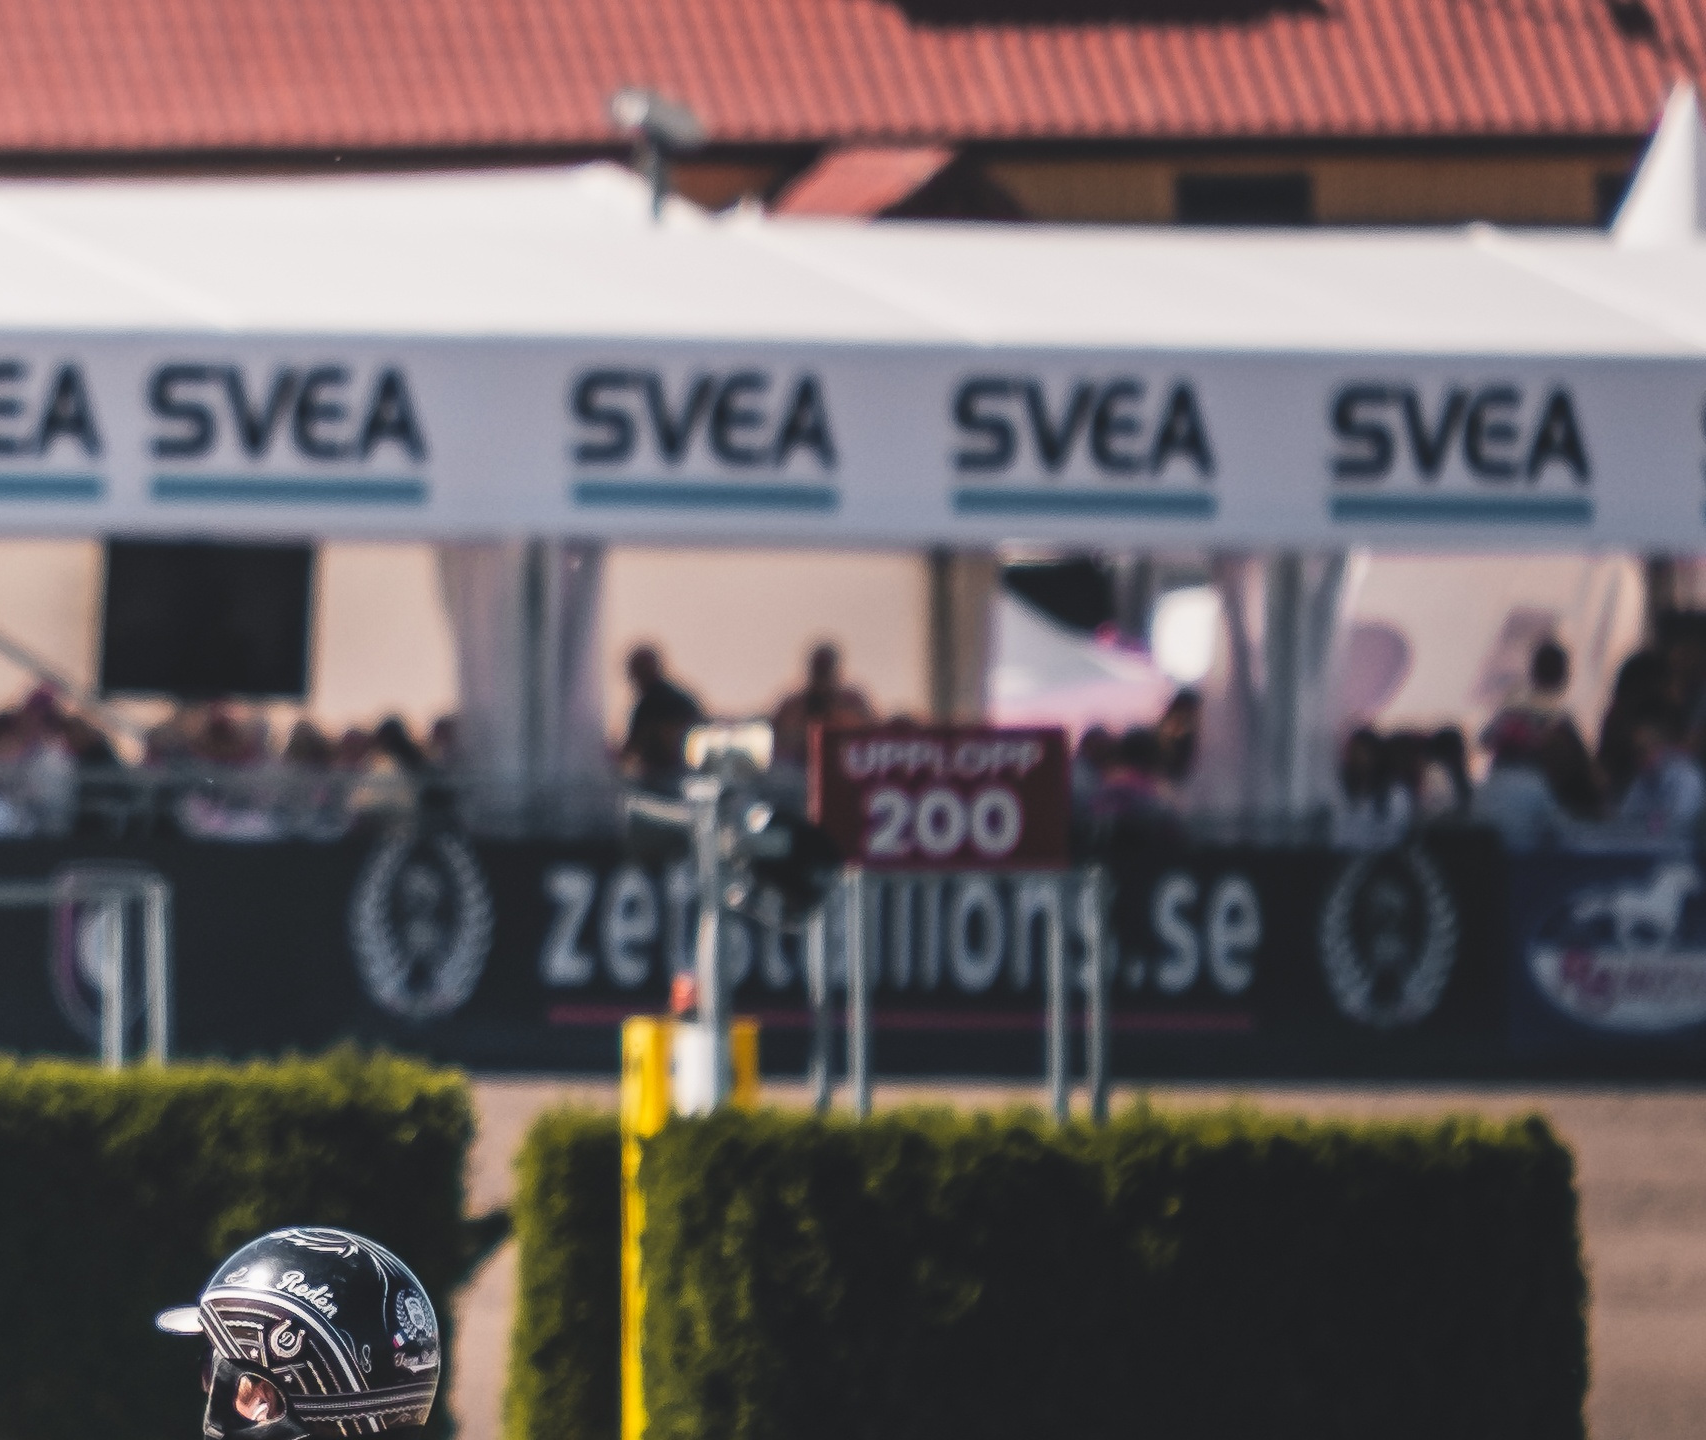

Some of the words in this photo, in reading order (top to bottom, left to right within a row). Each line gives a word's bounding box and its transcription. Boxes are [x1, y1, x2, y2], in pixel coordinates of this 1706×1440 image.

[147, 362, 427, 464] SVEA
[570, 369, 837, 472] SVEA
[951, 376, 1215, 478] SVEA
[1329, 381, 1593, 484] SVEA
[843, 738, 1044, 775] UPPLOPP
[867, 787, 1023, 857] 200
